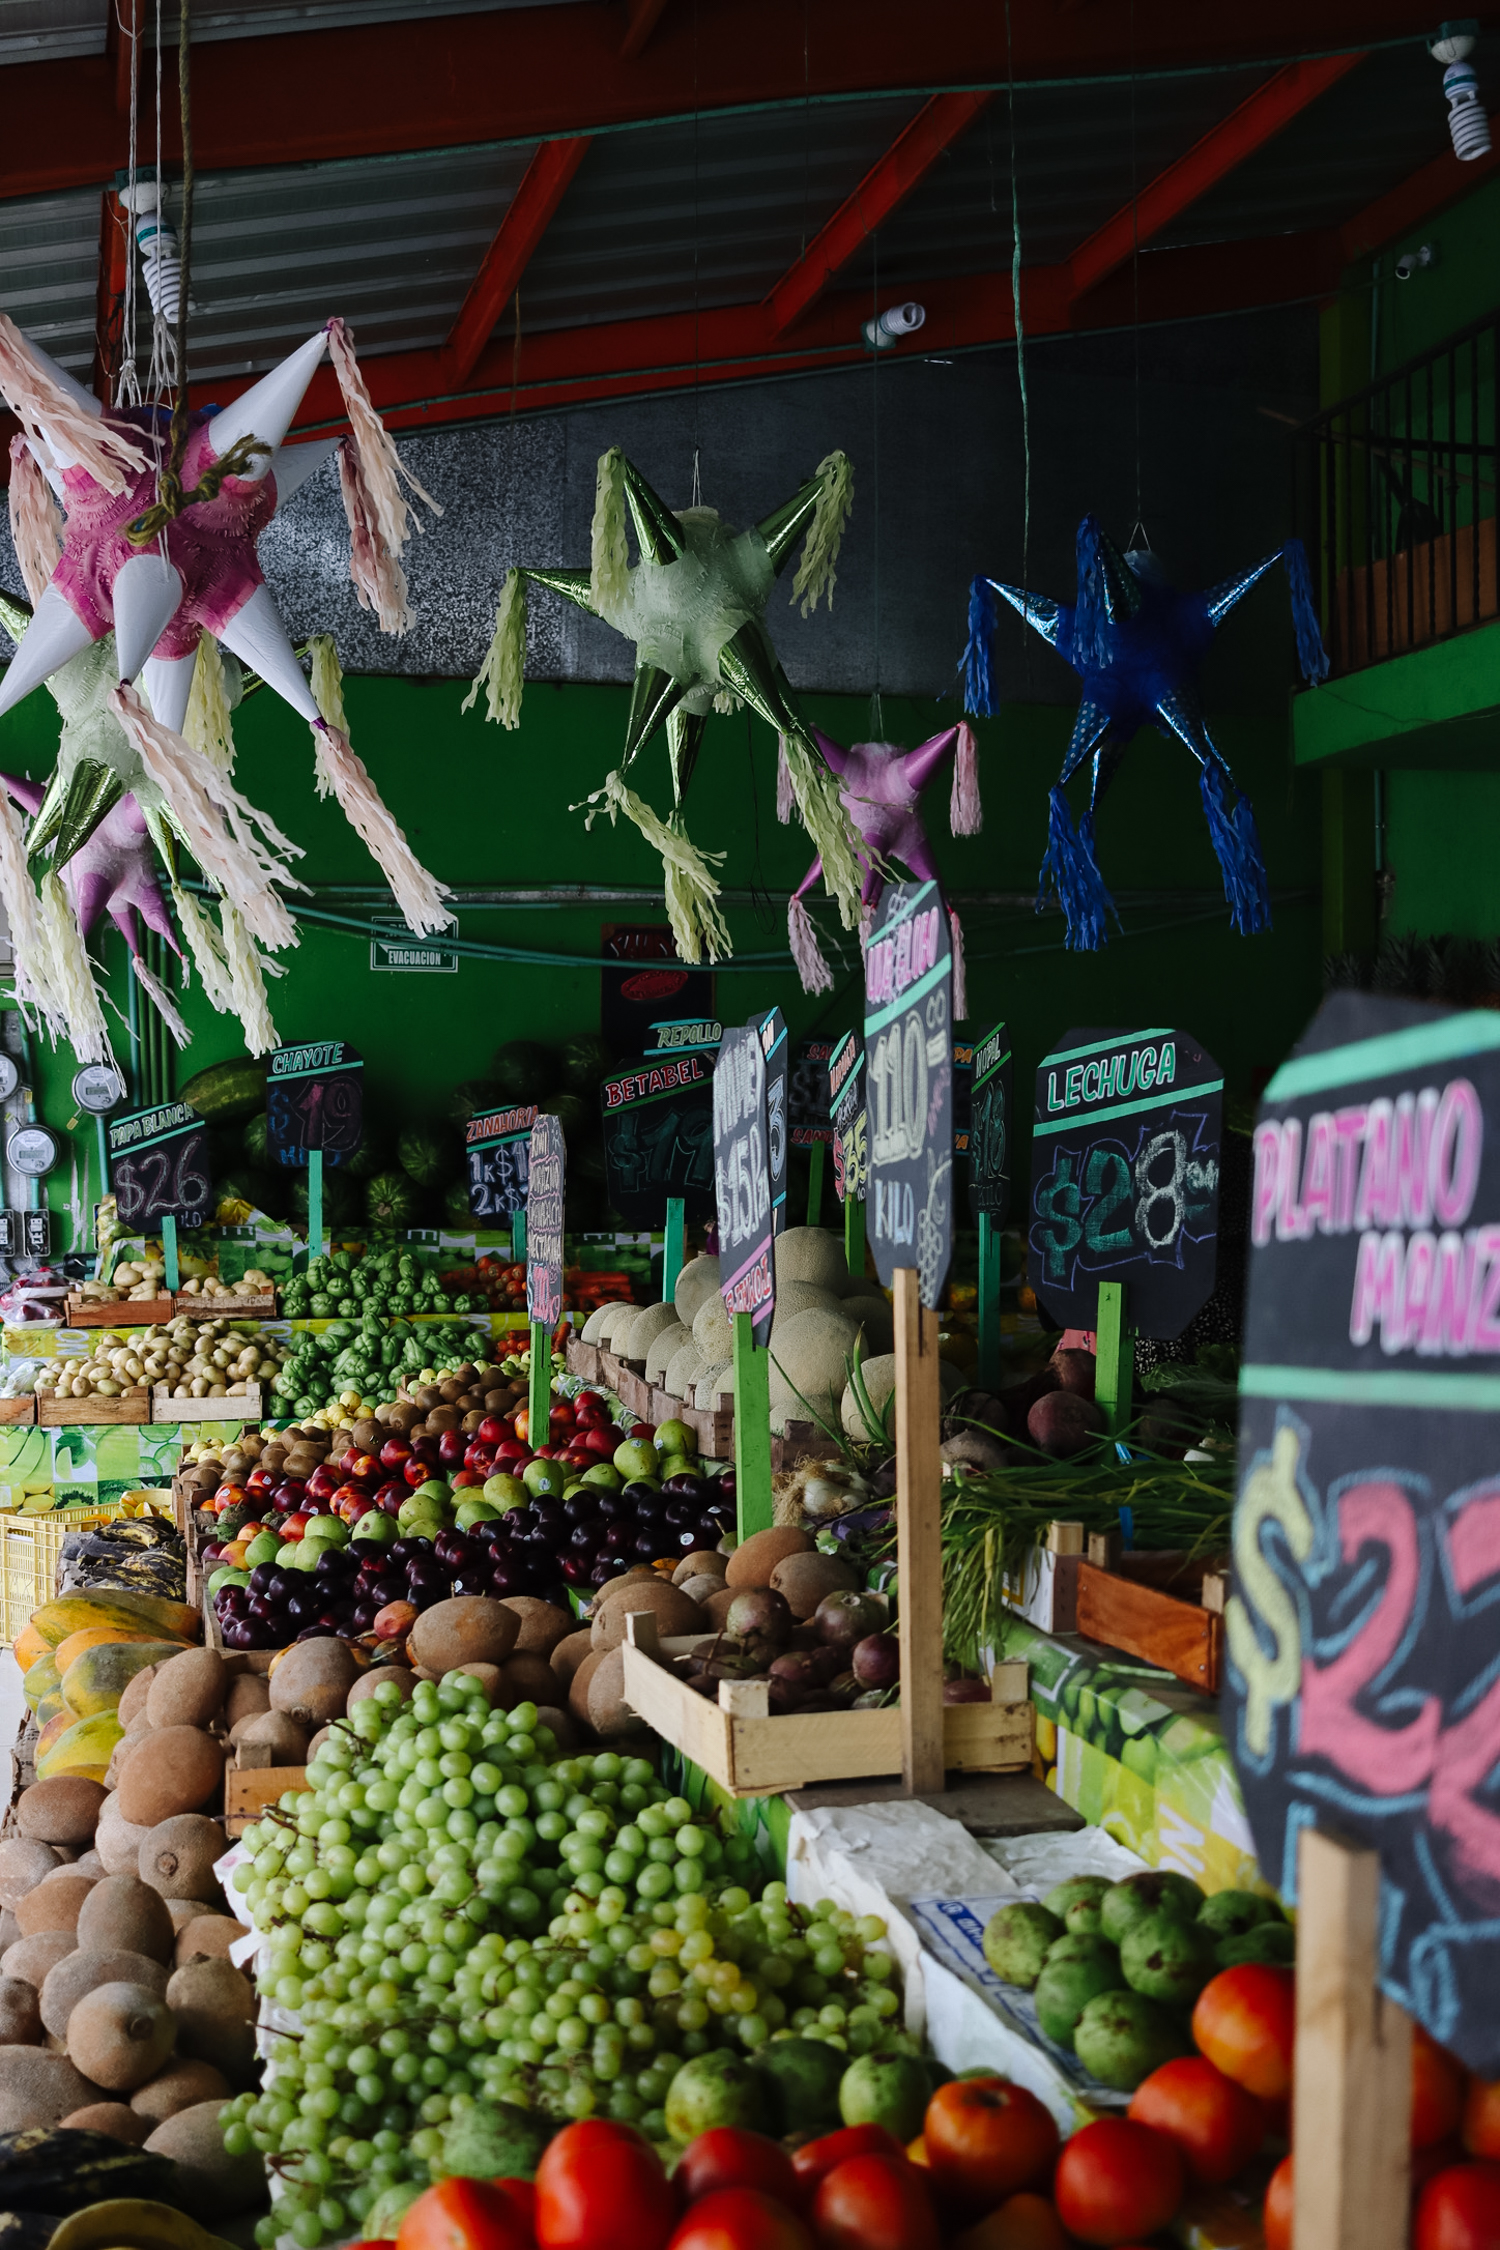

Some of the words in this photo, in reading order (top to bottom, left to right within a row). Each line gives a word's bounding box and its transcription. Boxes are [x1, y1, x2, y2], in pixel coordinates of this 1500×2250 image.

[388, 950, 441, 965] EVACUACION
[272, 1042, 344, 1075] CHAYOTE
[657, 1022, 722, 1048] REPOLLO
[605, 1057, 704, 1108] BETABEL
[1047, 1042, 1176, 1112] LECHUGA
[109, 1120, 142, 1148] PAPA
[142, 1102, 195, 1137] BLANCA
[466, 1104, 539, 1143] ZANAHORIA
[114, 1135, 209, 1221] $26
[1250, 1076, 1485, 1247] PLATANO
[873, 1177, 914, 1247] KILO
[1036, 1130, 1188, 1278] $28
